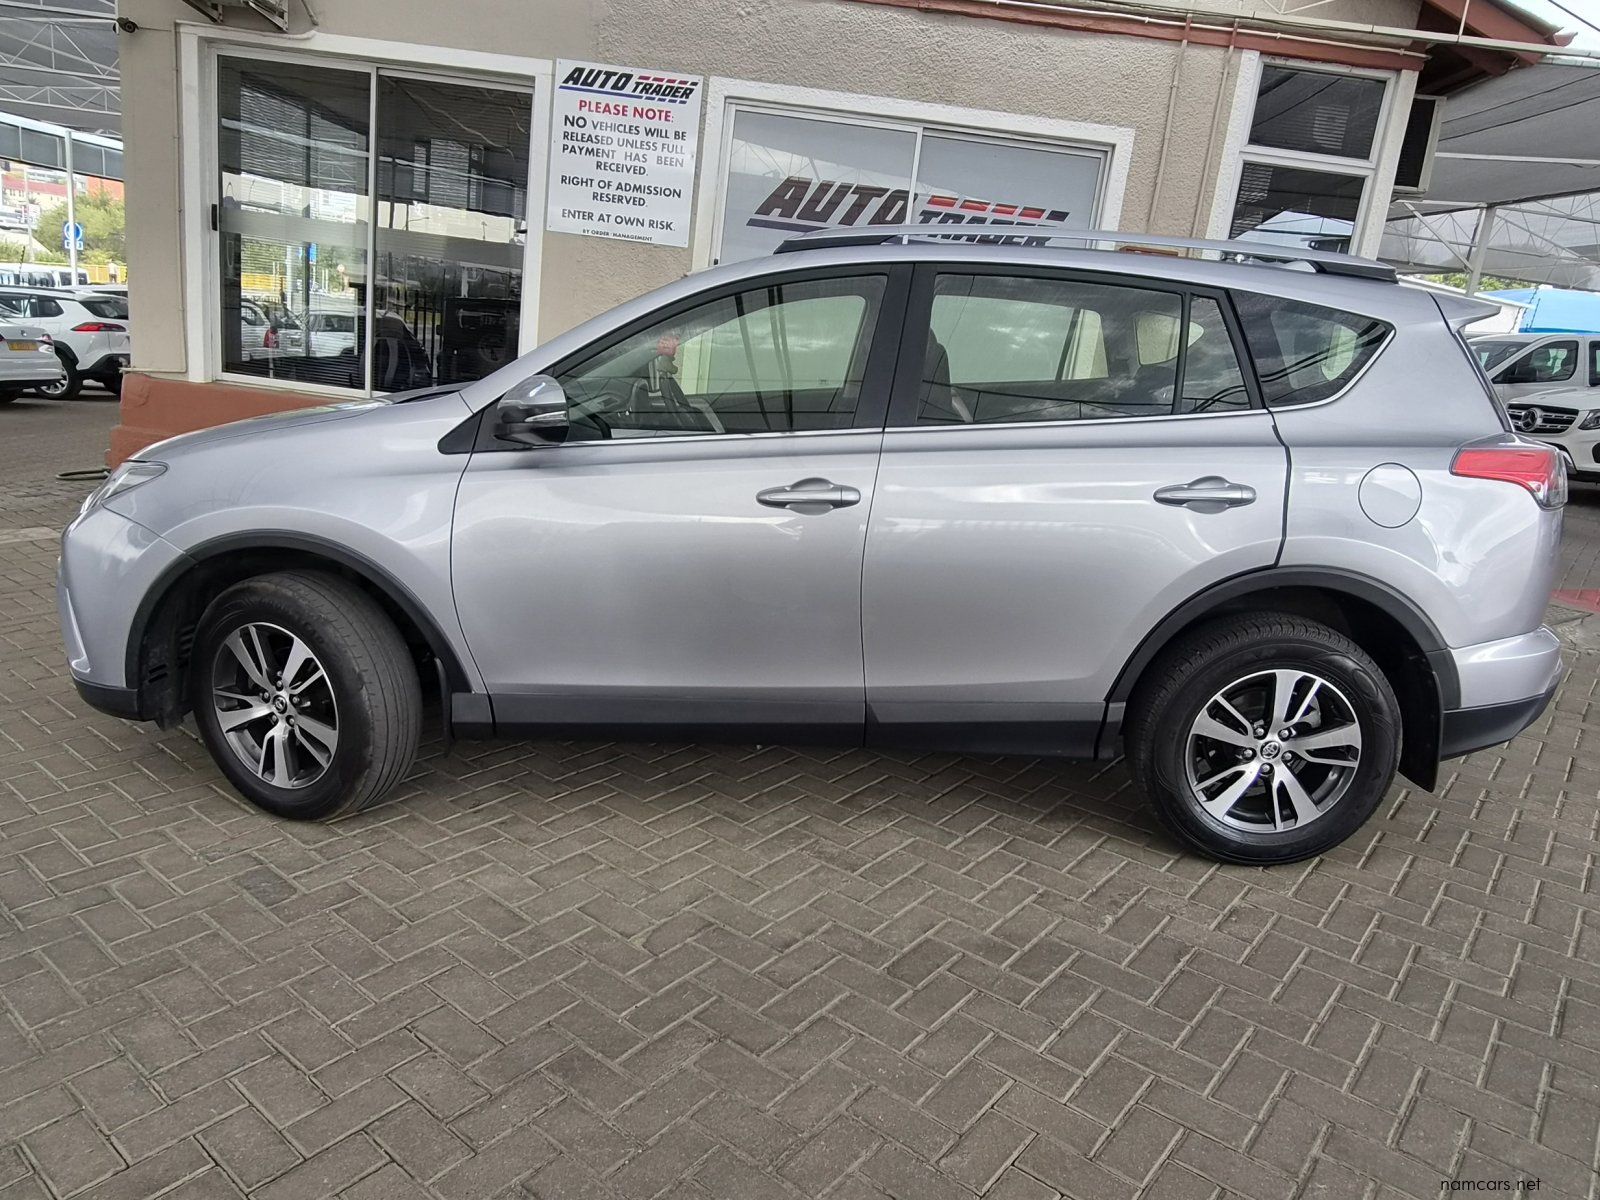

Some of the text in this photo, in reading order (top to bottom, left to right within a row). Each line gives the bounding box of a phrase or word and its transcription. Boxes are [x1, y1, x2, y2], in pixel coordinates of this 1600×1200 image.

[562, 67, 695, 100] AUTO TRADER
[579, 100, 674, 123] PLEASE NOTE:
[564, 115, 687, 141] NO VEHICLES WILL BE
[563, 131, 685, 155] RELEASED UNLESS FULL
[562, 144, 684, 168] PAYMENT HAS BEEN
[596, 161, 649, 177] RECEIVED.
[560, 175, 682, 199] RIGHT OF ADMISSION
[592, 192, 648, 208] RESERVED.
[754, 175, 919, 226] AUTO
[561, 208, 676, 232] ENTER AT OWN RISK.
[591, 229, 610, 237] ORDER
[612, 231, 653, 242] MANAGEMENT
